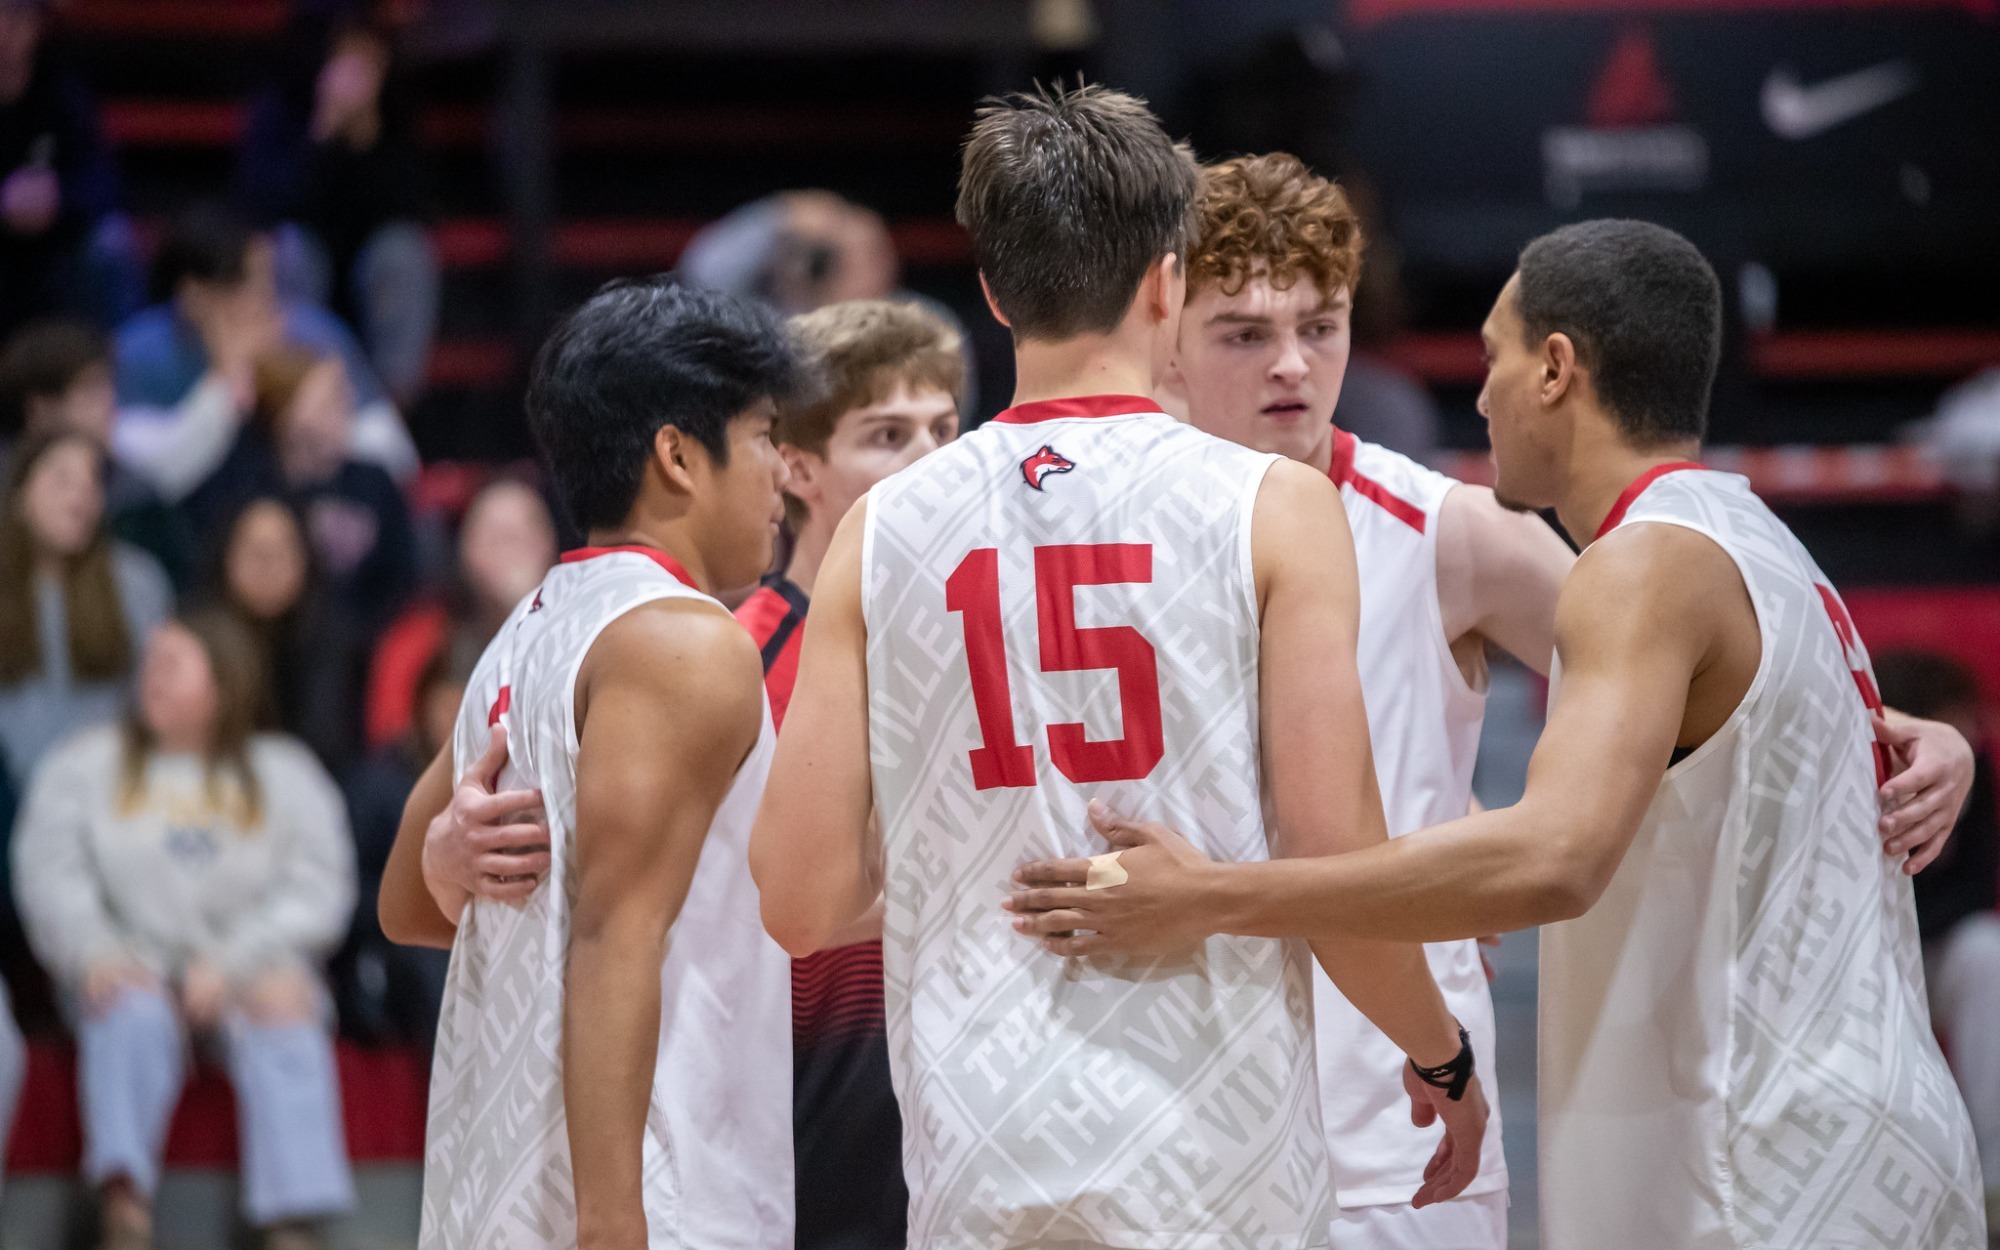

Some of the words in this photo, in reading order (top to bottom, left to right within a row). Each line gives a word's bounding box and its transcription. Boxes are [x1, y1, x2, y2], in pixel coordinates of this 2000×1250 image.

[945, 543, 1165, 791] 15
[1020, 1048, 1147, 1168] THE
[1097, 1125, 1223, 1238] THE
[1194, 1000, 1303, 1147] VILL
